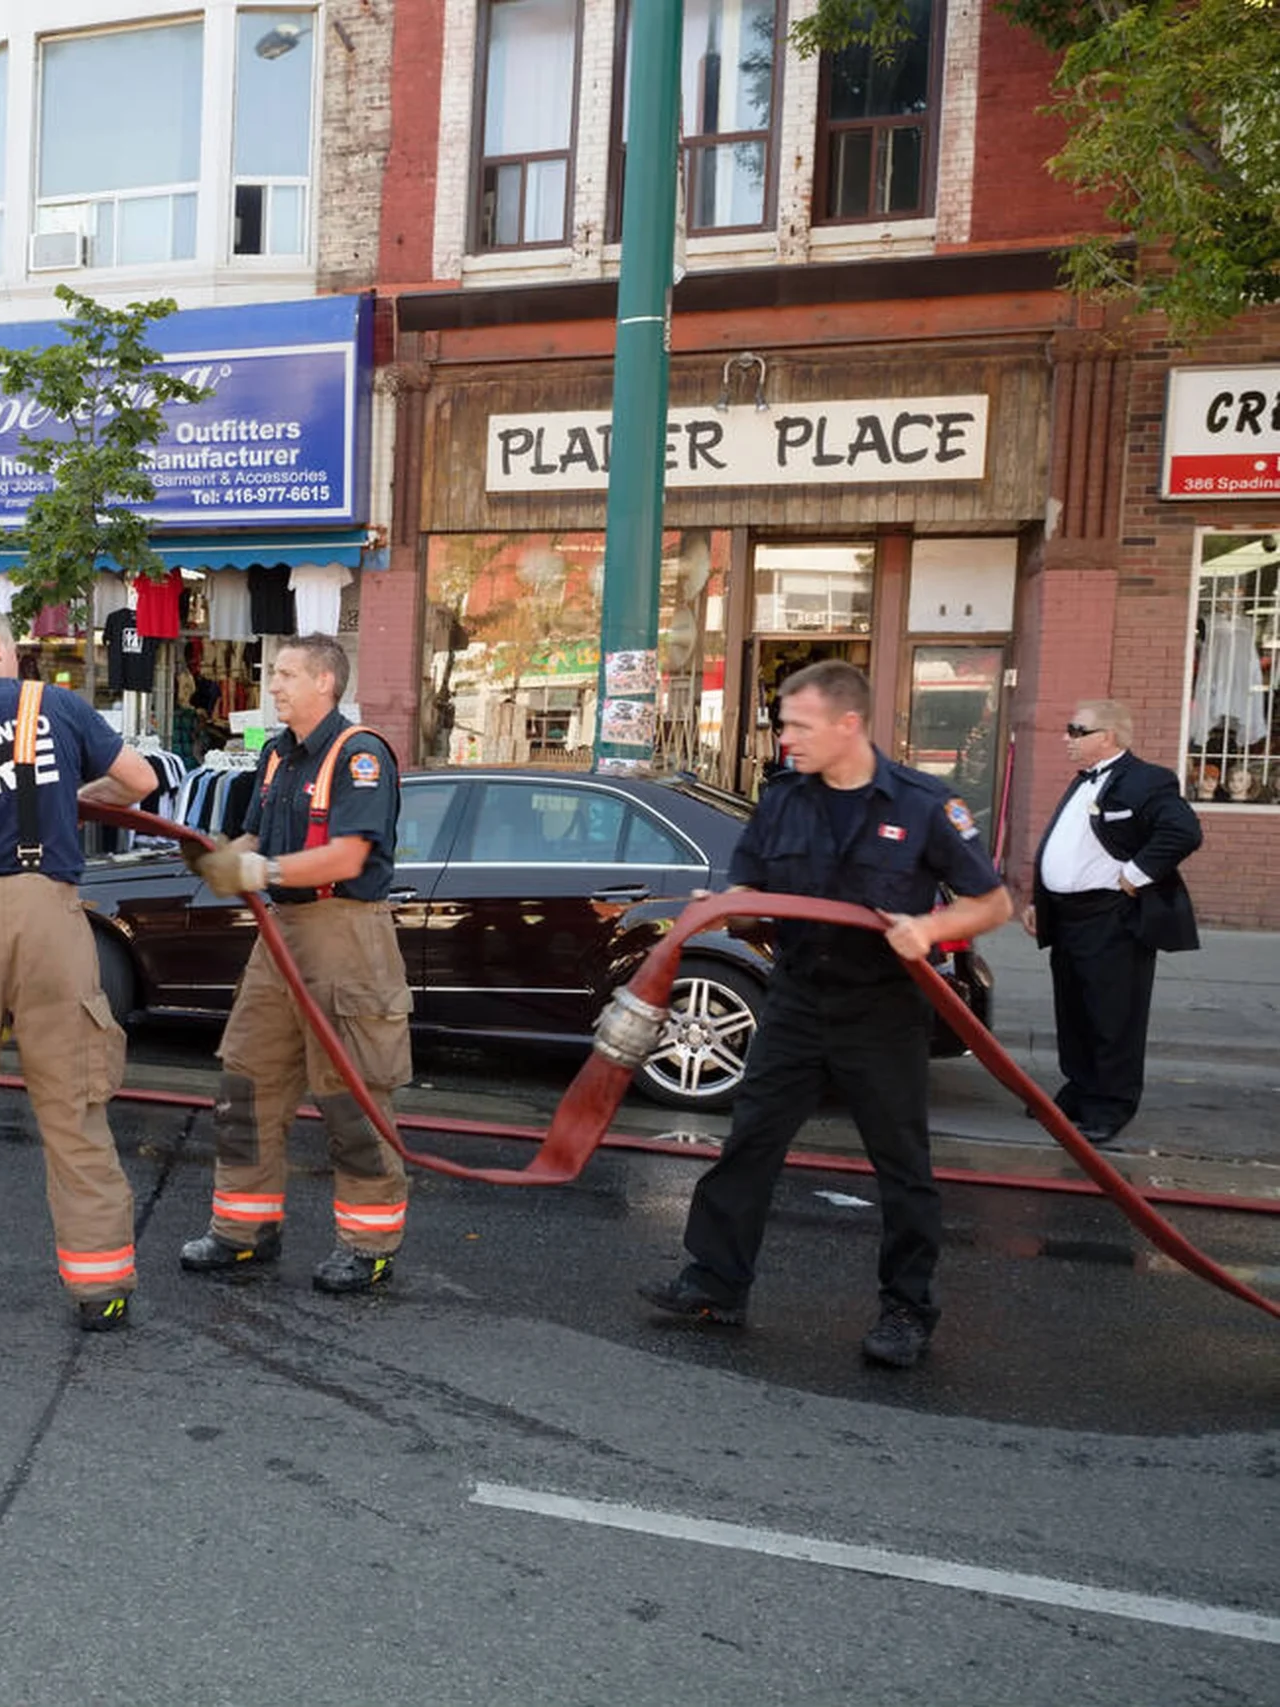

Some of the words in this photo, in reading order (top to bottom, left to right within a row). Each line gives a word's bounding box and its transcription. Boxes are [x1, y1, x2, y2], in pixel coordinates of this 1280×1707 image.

[1206, 391, 1280, 436] CR
[176, 421, 301, 443] Outfitters
[775, 411, 974, 467] PLACE
[138, 447, 300, 470] Manufacturer
[152, 472, 216, 487] Garment
[220, 471, 231, 485] &
[234, 469, 327, 485] Accessories
[1184, 478, 1214, 491] 386
[192, 490, 220, 504] Tel:
[224, 486, 330, 504] 416-977-6615
